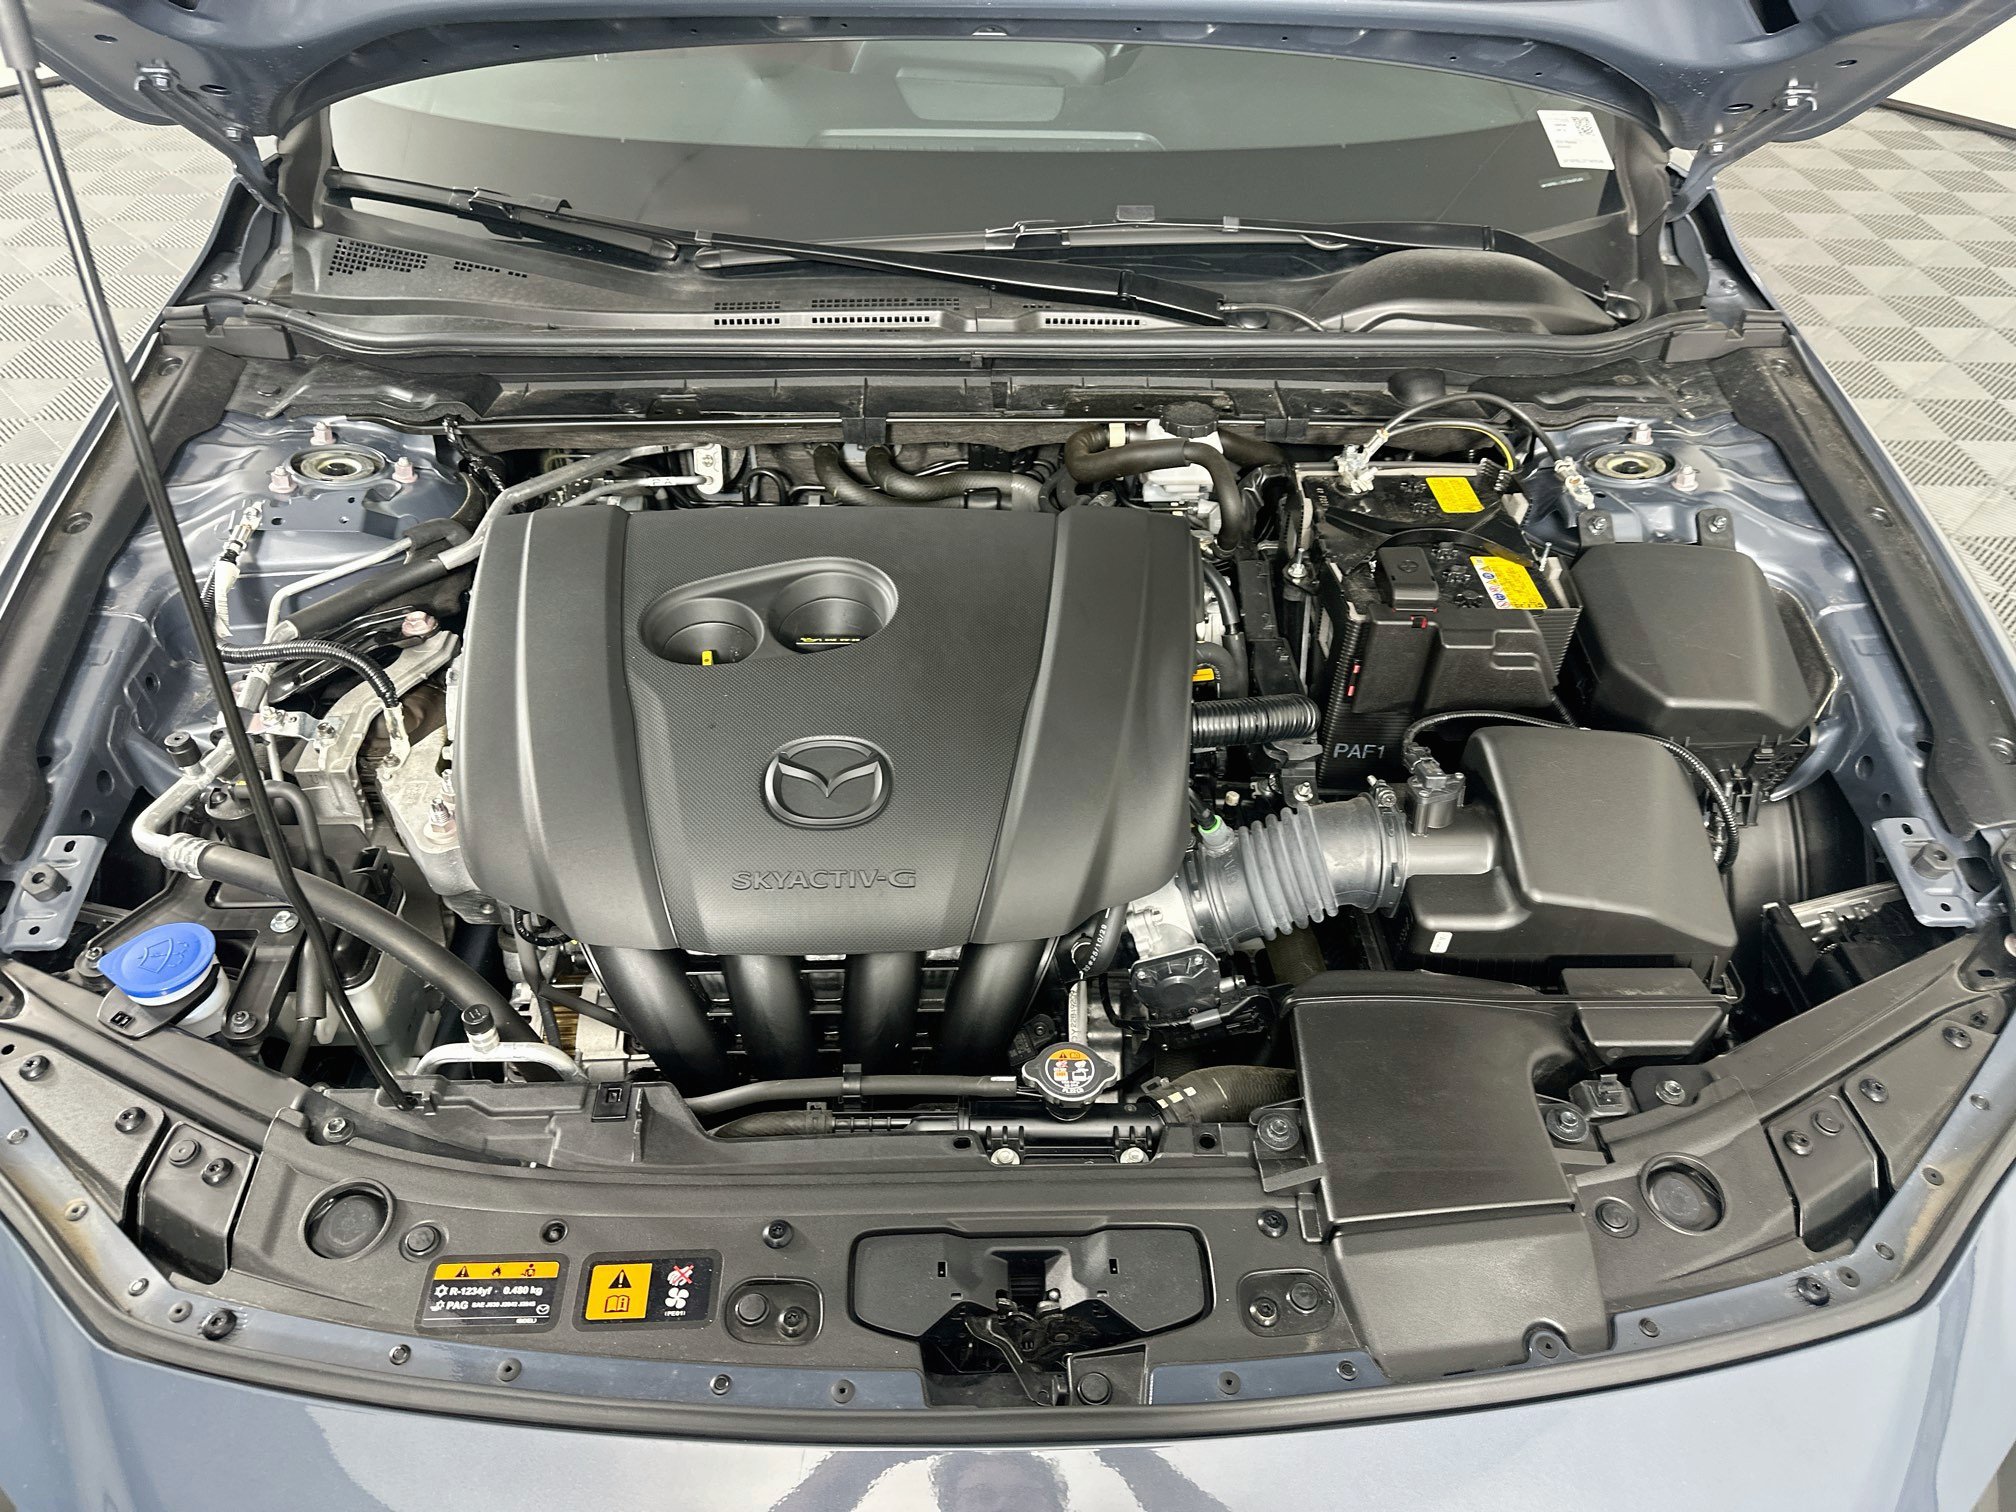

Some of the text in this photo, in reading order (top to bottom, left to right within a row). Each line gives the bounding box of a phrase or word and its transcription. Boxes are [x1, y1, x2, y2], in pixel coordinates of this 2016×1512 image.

[1333, 742, 1385, 759] PAF1
[731, 868, 917, 890] SKYACTIV-G
[449, 1286, 493, 1297] R-1234yf
[529, 1286, 543, 1296] kg
[445, 1300, 469, 1310] PAG
